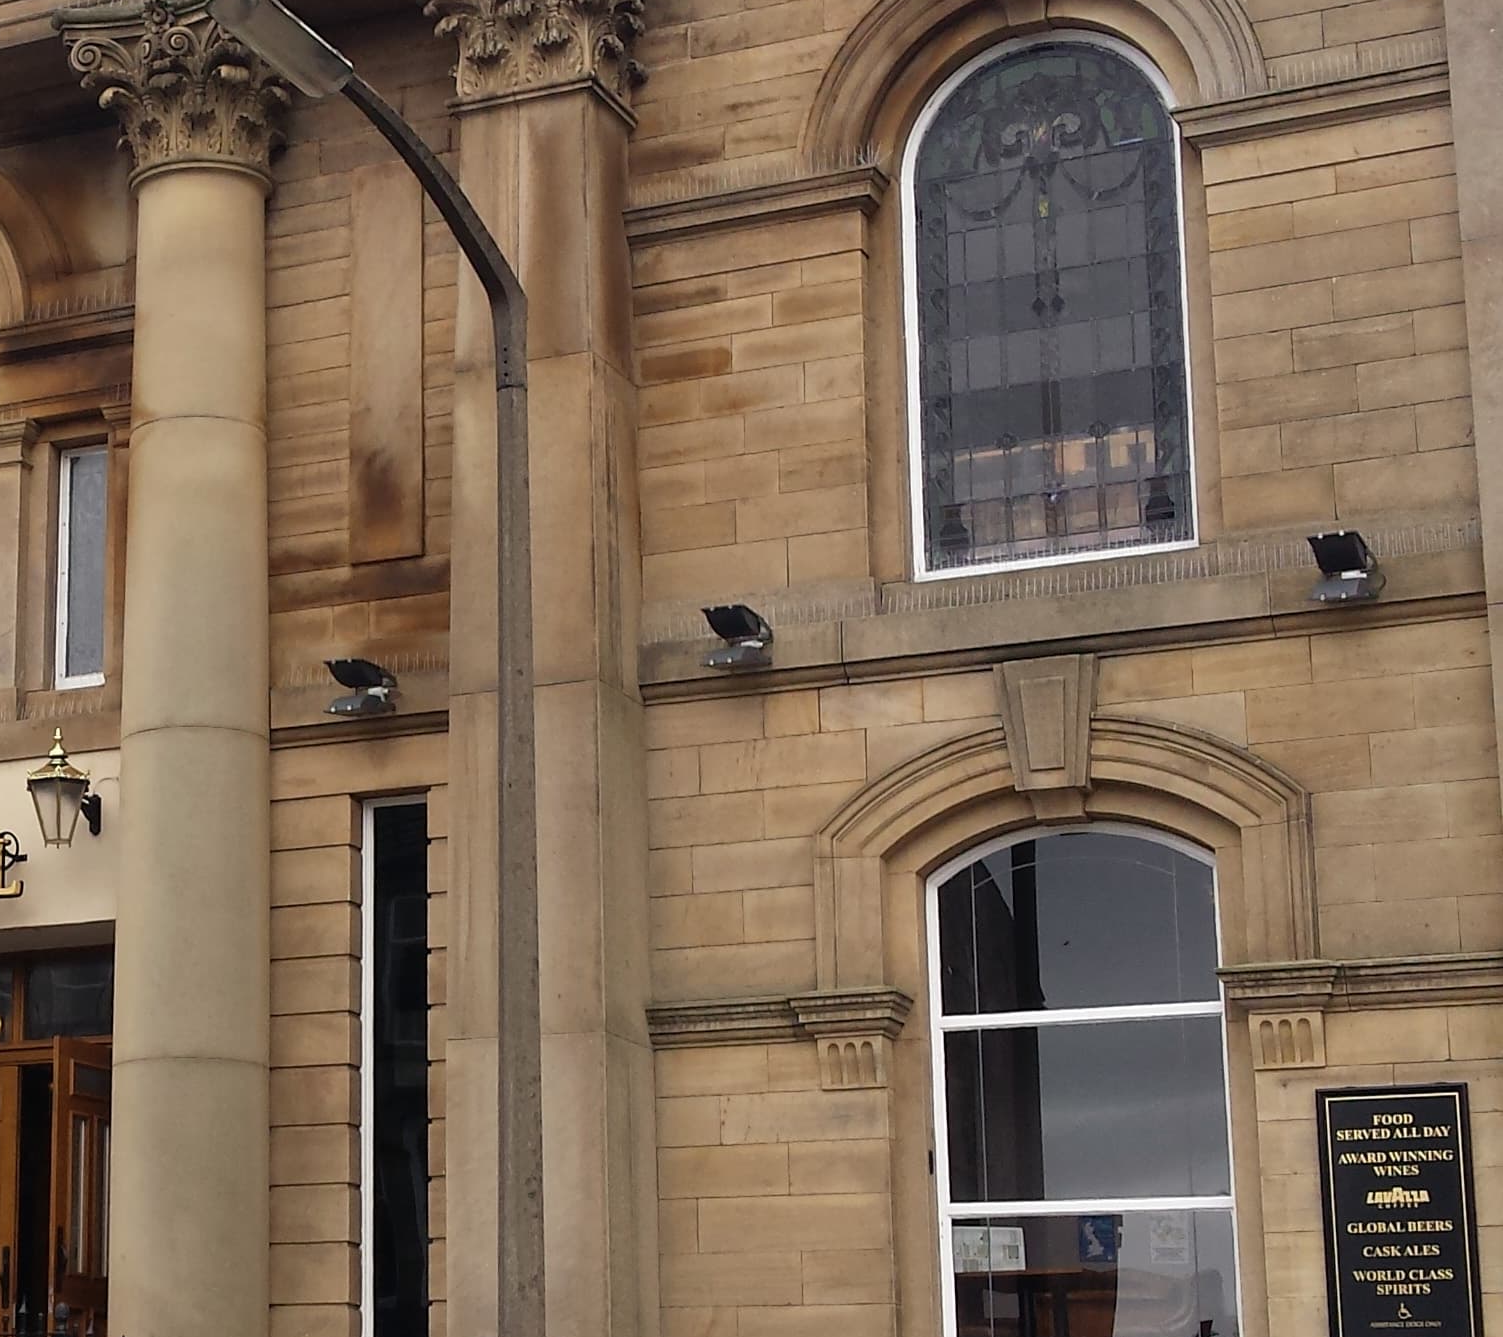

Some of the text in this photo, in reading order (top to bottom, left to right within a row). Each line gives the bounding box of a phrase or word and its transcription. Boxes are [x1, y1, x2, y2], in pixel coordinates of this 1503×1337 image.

[1372, 1113, 1414, 1126] FOOD
[1336, 1125, 1451, 1141] SERVED ALL DAY
[1338, 1149, 1454, 1165] AWARD WINNING
[1373, 1164, 1420, 1177] WINES
[1346, 1220, 1454, 1234] GLOBAL BEERS
[1362, 1244, 1441, 1257] CASK ALES
[1352, 1268, 1454, 1282] WORLD CLASS
[1376, 1282, 1432, 1296] SPIRITS
